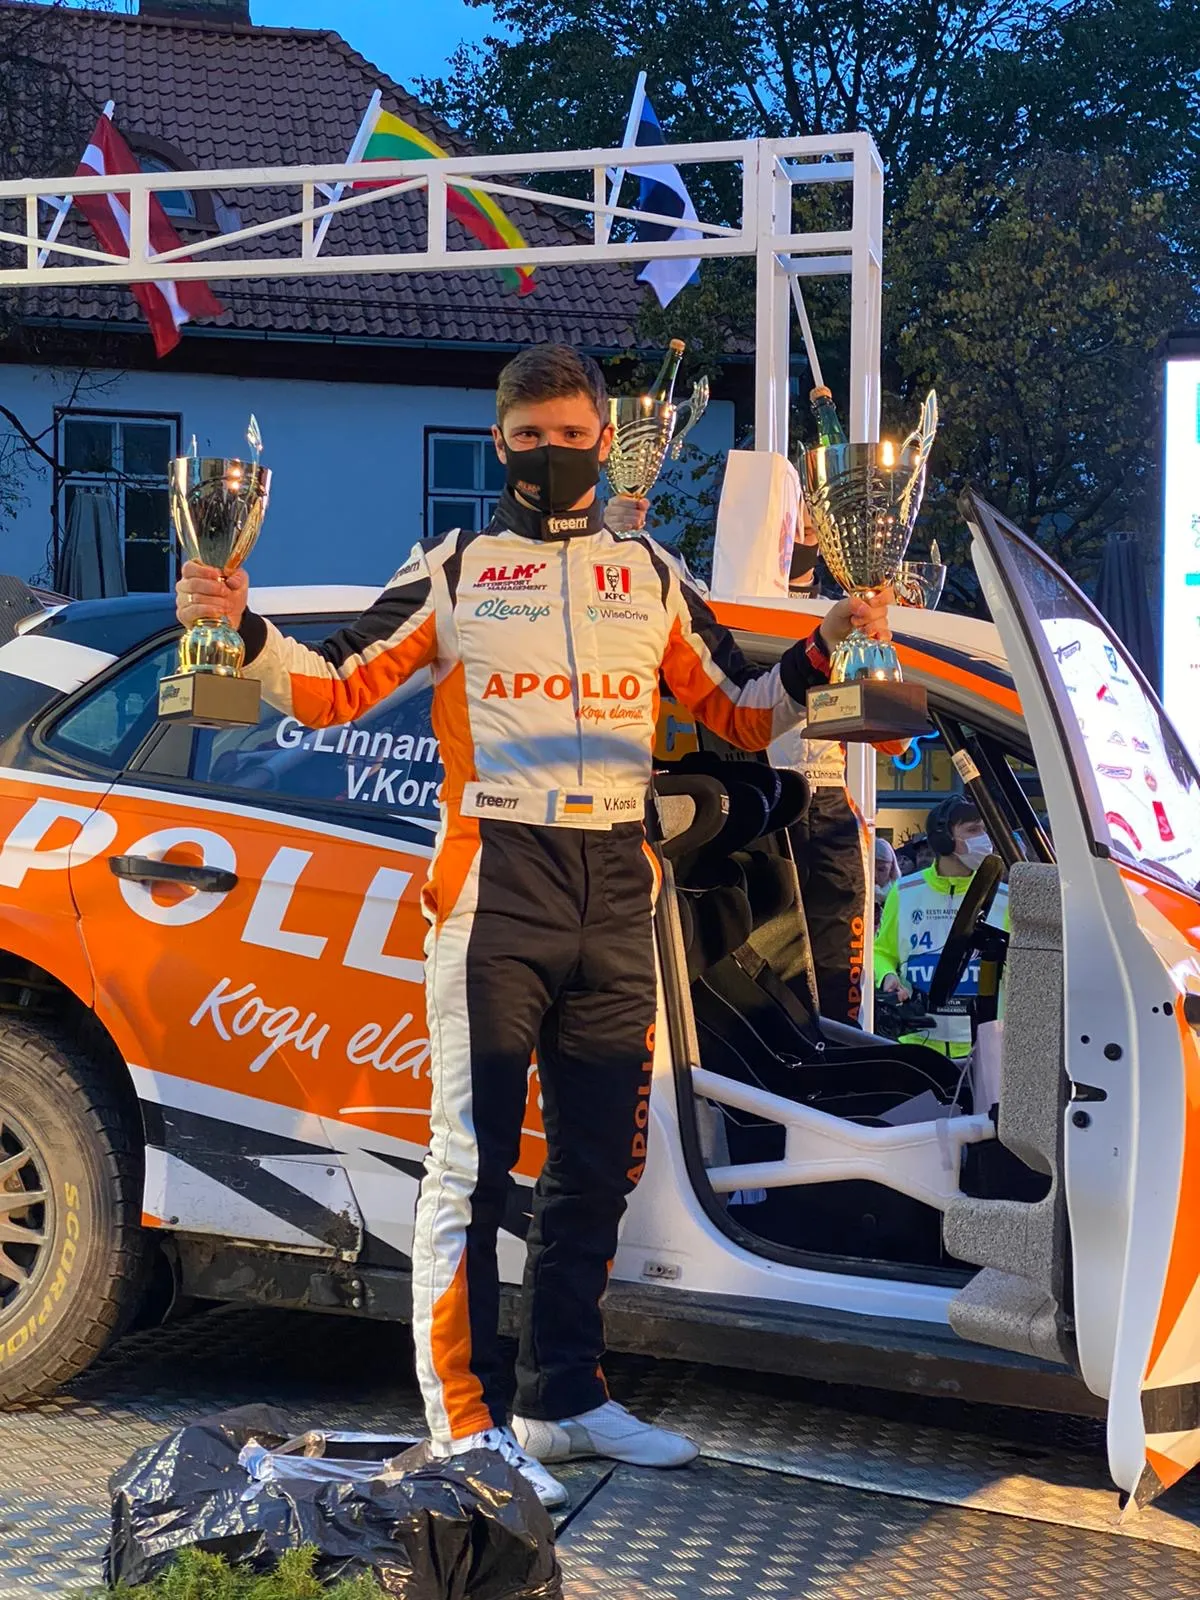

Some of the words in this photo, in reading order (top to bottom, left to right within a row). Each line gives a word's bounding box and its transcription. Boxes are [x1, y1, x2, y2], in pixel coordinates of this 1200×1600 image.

[548, 517, 589, 533] freem
[478, 564, 546, 582] ALM
[473, 580, 531, 588] MOTORSPORT
[605, 592, 626, 601] KFC
[475, 598, 550, 622] O'Learys
[600, 609, 649, 621] WiseDrive
[481, 672, 641, 701] APOLLO
[475, 792, 519, 810] freem
[907, 966, 934, 982] TV
[189, 977, 330, 1072] Kogu
[346, 1012, 432, 1080] ela
